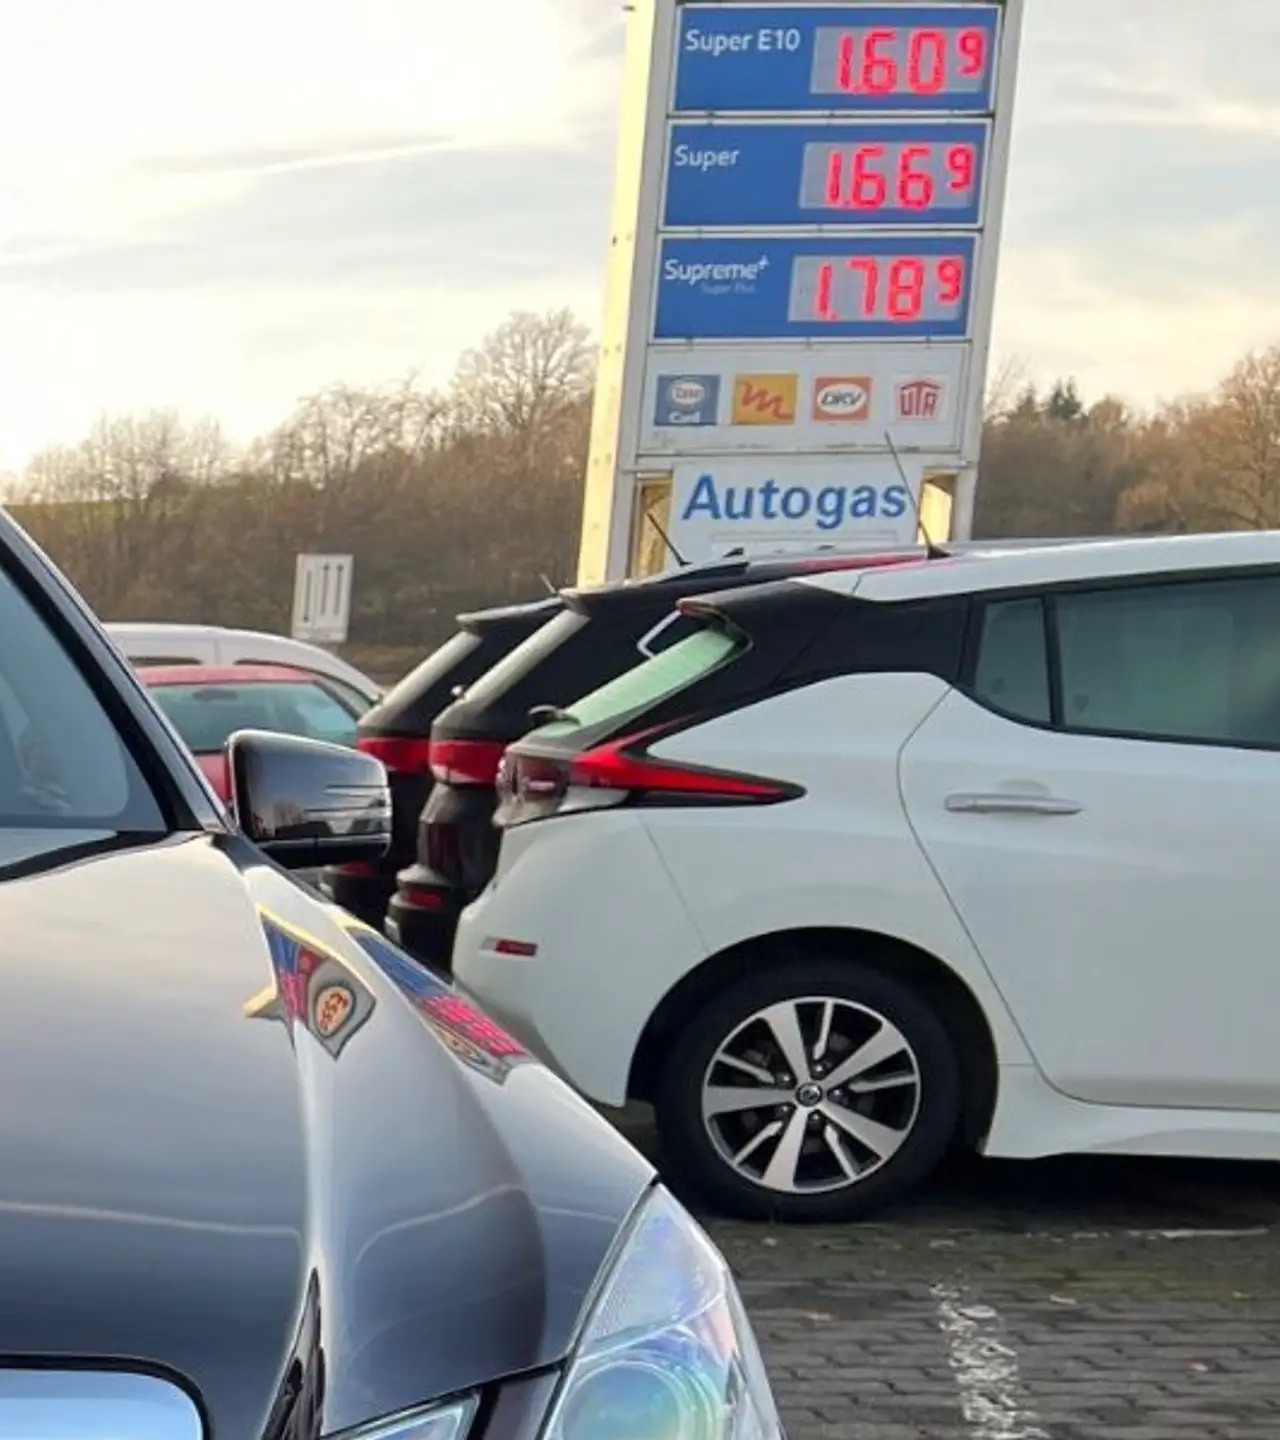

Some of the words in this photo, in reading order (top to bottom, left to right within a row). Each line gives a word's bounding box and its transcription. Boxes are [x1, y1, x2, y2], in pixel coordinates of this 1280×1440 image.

[683, 28, 753, 55] Super
[758, 28, 801, 51] E10
[674, 144, 741, 172] Super
[681, 473, 908, 530] Autogas
